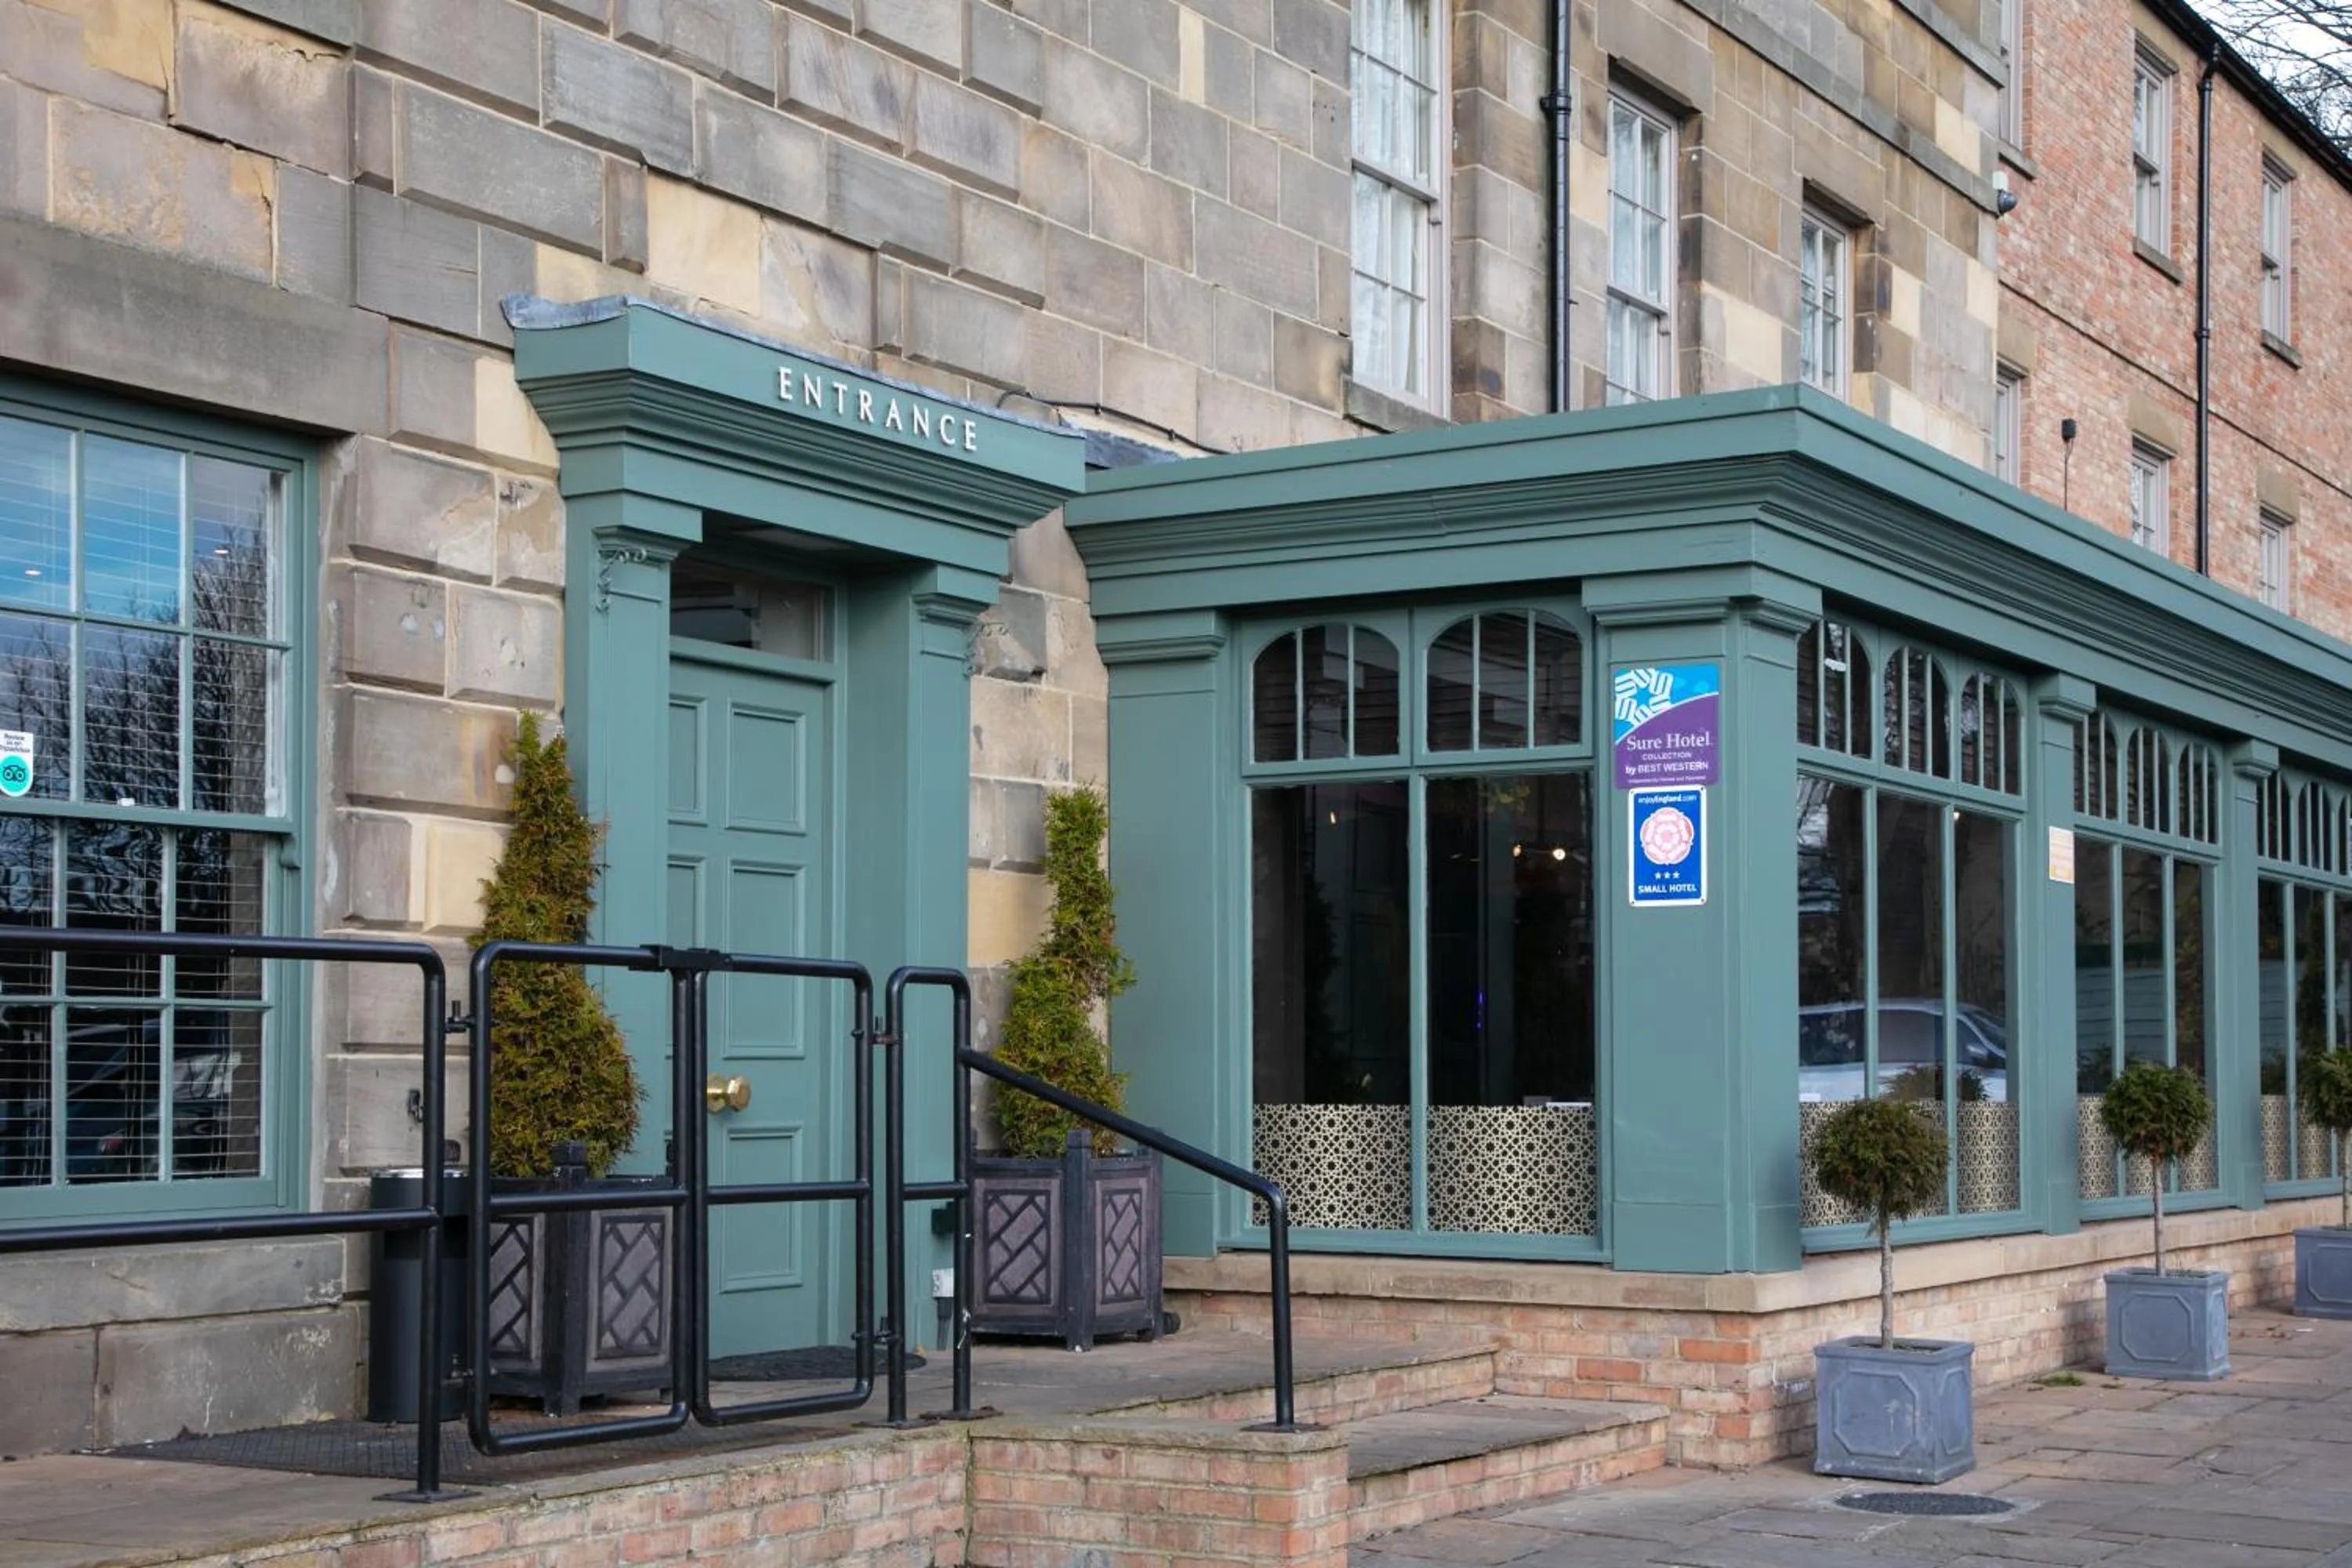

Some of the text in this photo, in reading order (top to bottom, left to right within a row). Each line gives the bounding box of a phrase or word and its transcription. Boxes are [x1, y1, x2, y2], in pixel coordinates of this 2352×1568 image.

[778, 366, 977, 452] ENTRANCE
[1627, 731, 1711, 750] Sure Hotel
[1642, 752, 1692, 761] COLLECTION
[1625, 761, 1709, 775] by BEST WESTERN
[1638, 884, 1697, 895] SMALL HOTEL
